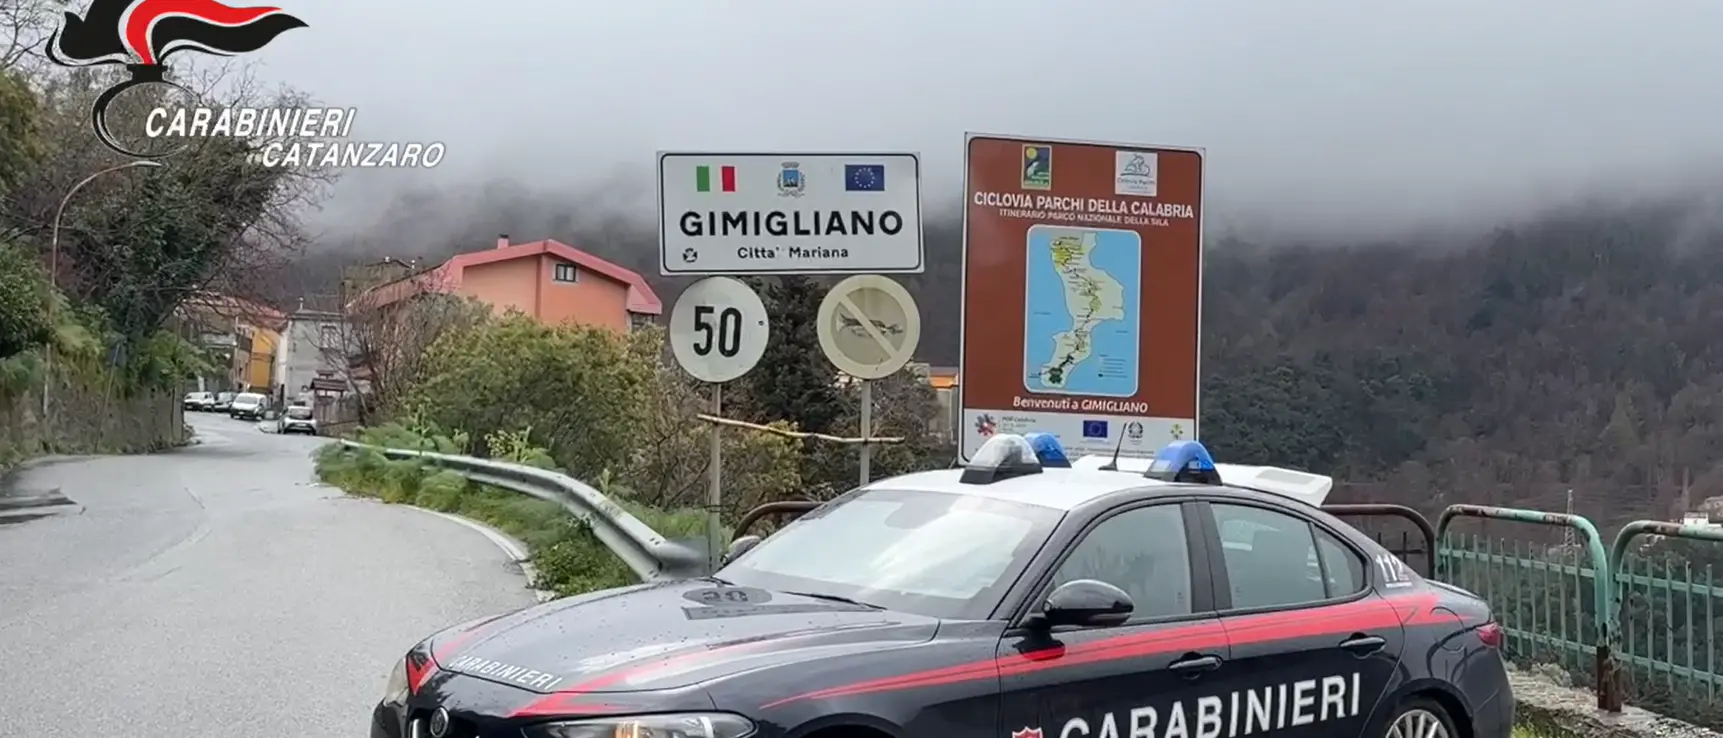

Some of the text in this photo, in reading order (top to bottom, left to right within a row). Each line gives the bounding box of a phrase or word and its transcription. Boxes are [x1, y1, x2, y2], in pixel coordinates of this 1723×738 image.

[974, 192, 1194, 218] CICLOVIA PARCHI DELLA CALABRIA
[679, 210, 904, 237] GIMIGLIANO
[788, 246, 850, 259] Mariana
[693, 305, 743, 358] 50
[1013, 395, 1149, 413] Benvenuti a GIMIGLIANO
[1375, 553, 1410, 582] 112
